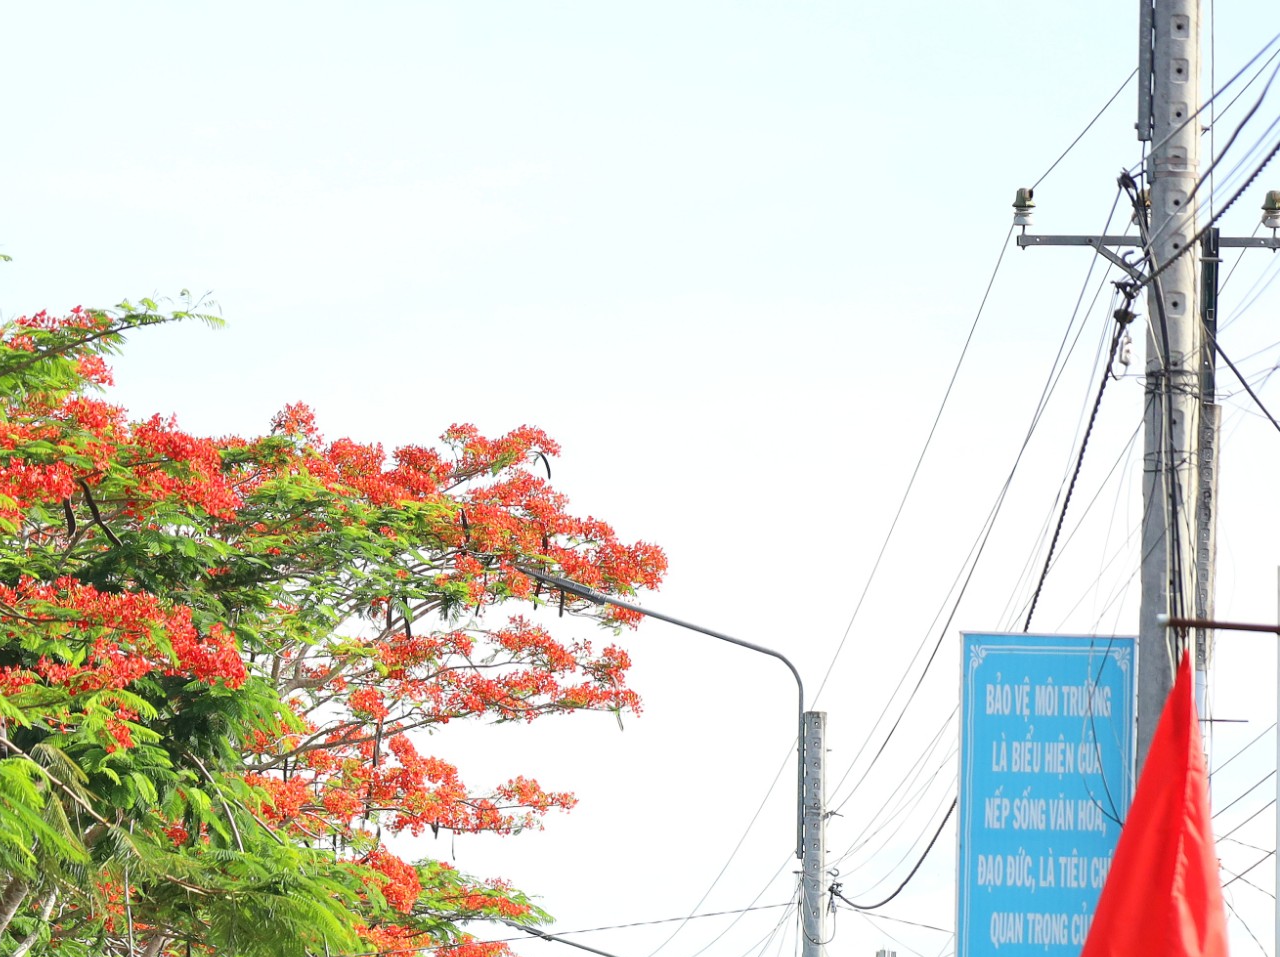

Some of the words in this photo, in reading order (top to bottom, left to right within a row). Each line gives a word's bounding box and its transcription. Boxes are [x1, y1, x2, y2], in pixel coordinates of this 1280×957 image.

[986, 672, 1012, 716] BẢO
[1014, 676, 1031, 722] VỆ
[1035, 676, 1059, 716] MÔI
[1062, 680, 1112, 717] TRƯỜNG
[992, 732, 1008, 772] LÀ
[1011, 725, 1042, 774] BIỂU
[1044, 733, 1075, 781] HIỆN
[1078, 730, 1103, 774] CỦA
[984, 785, 1011, 829] NẾP
[1013, 785, 1047, 830] SỐNG
[1049, 792, 1074, 831] VĂN
[977, 854, 1004, 893] ĐẠO
[1006, 846, 1036, 894] ĐỨC,
[1039, 847, 1055, 888] LÀ
[1059, 848, 1088, 888] TIÊU
[989, 911, 1023, 949] QUAN
[1027, 912, 1069, 952] TRỌNG
[1071, 901, 1094, 945] CỦ
